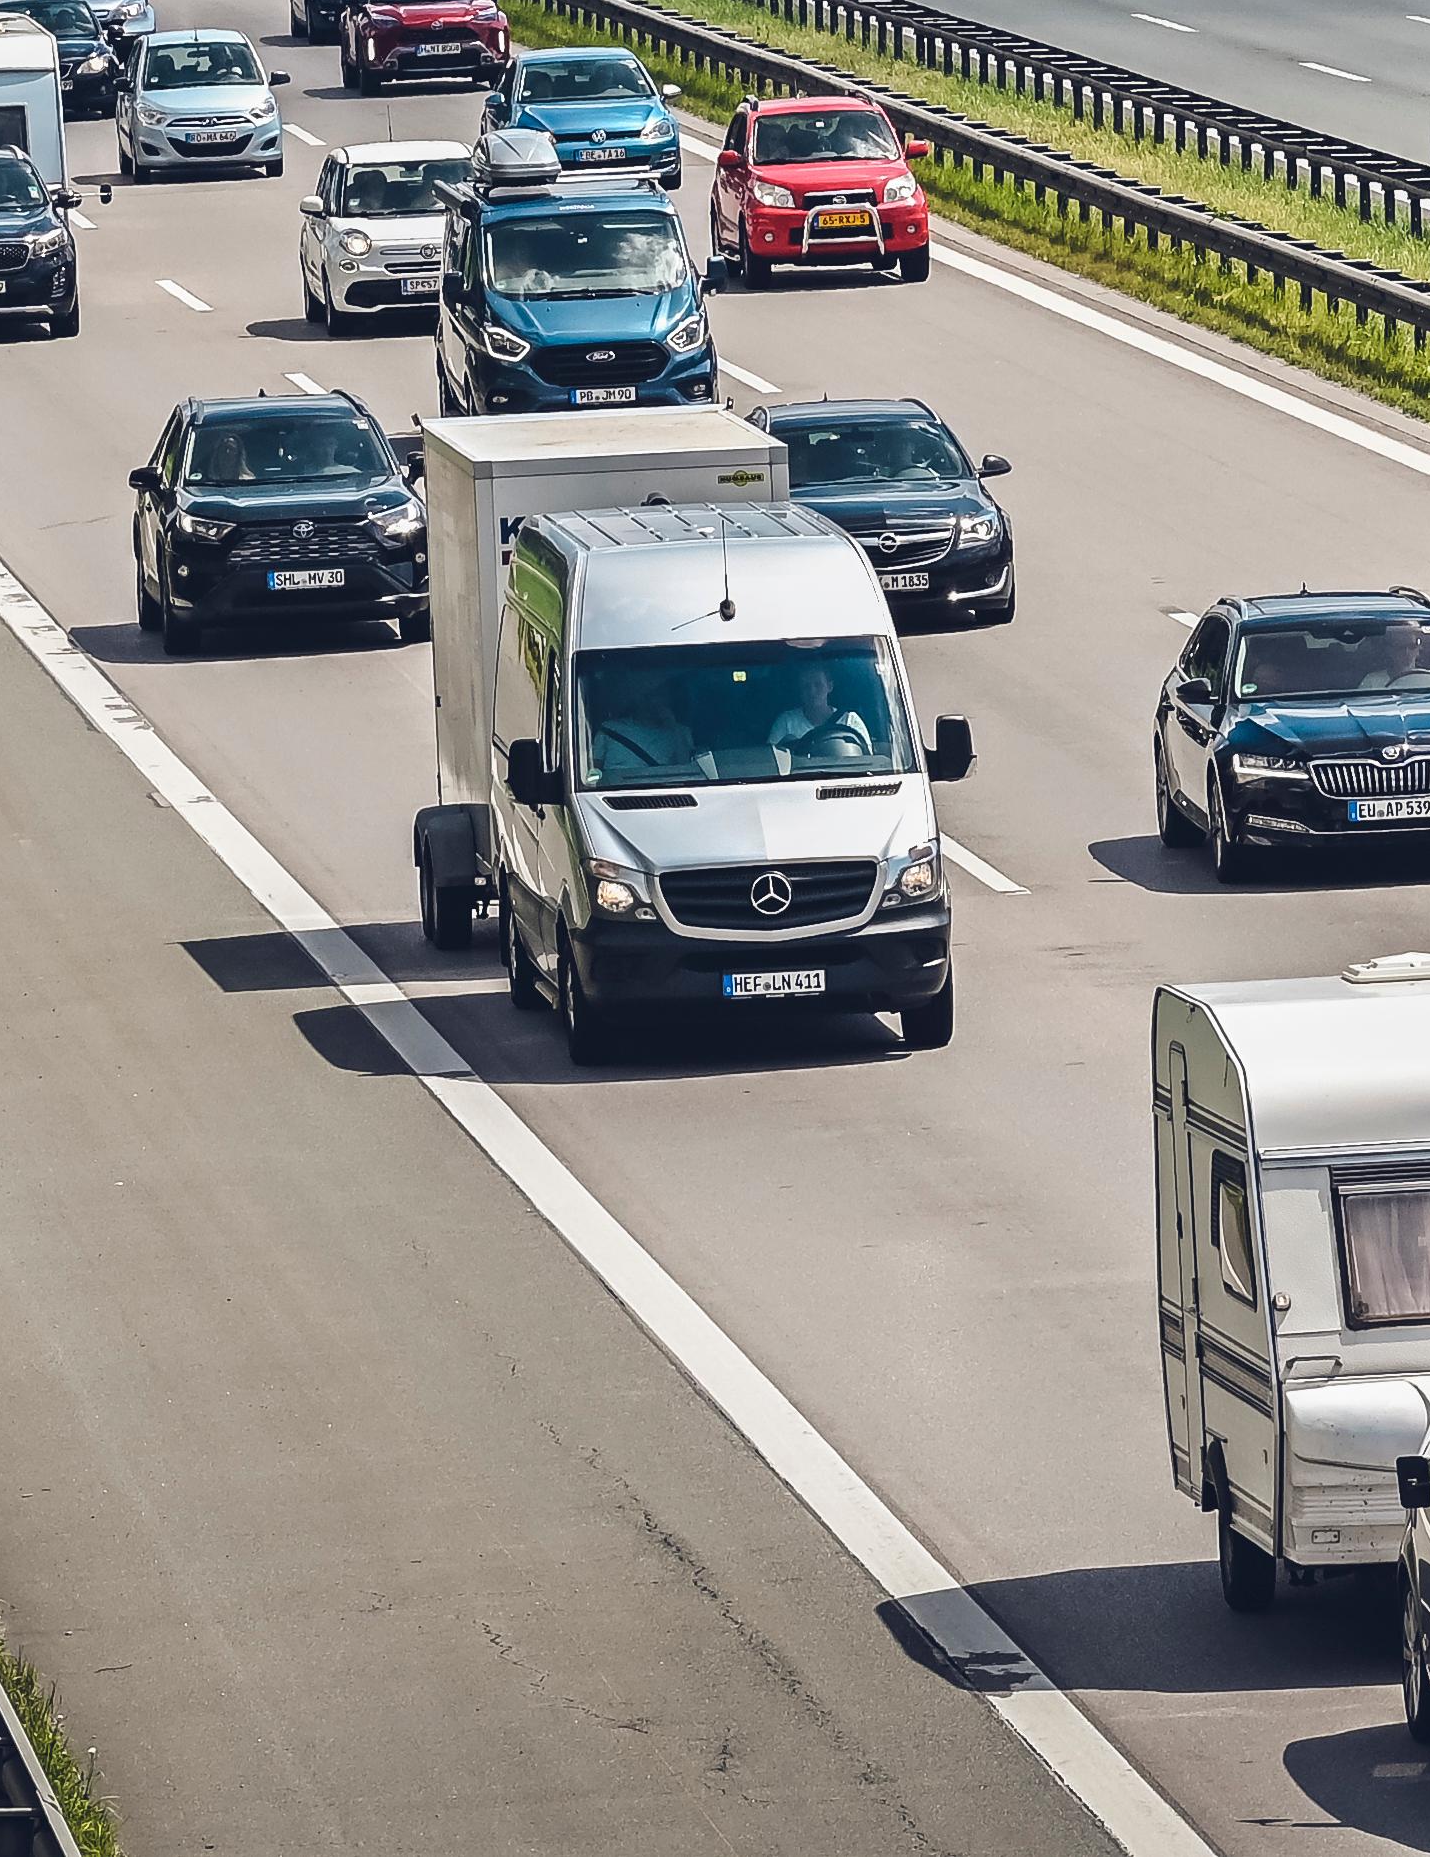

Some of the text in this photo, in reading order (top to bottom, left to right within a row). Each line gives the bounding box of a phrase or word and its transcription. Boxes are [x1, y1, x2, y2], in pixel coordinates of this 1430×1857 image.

[579, 390, 594, 402] PB
[617, 388, 632, 400] 90
[275, 571, 344, 587] SHL MV 30
[901, 574, 928, 588] 1835
[1358, 804, 1376, 819] EU
[1386, 802, 1403, 817] AP
[733, 973, 762, 992] HEF
[772, 972, 792, 990] LN
[794, 971, 822, 988] 411
